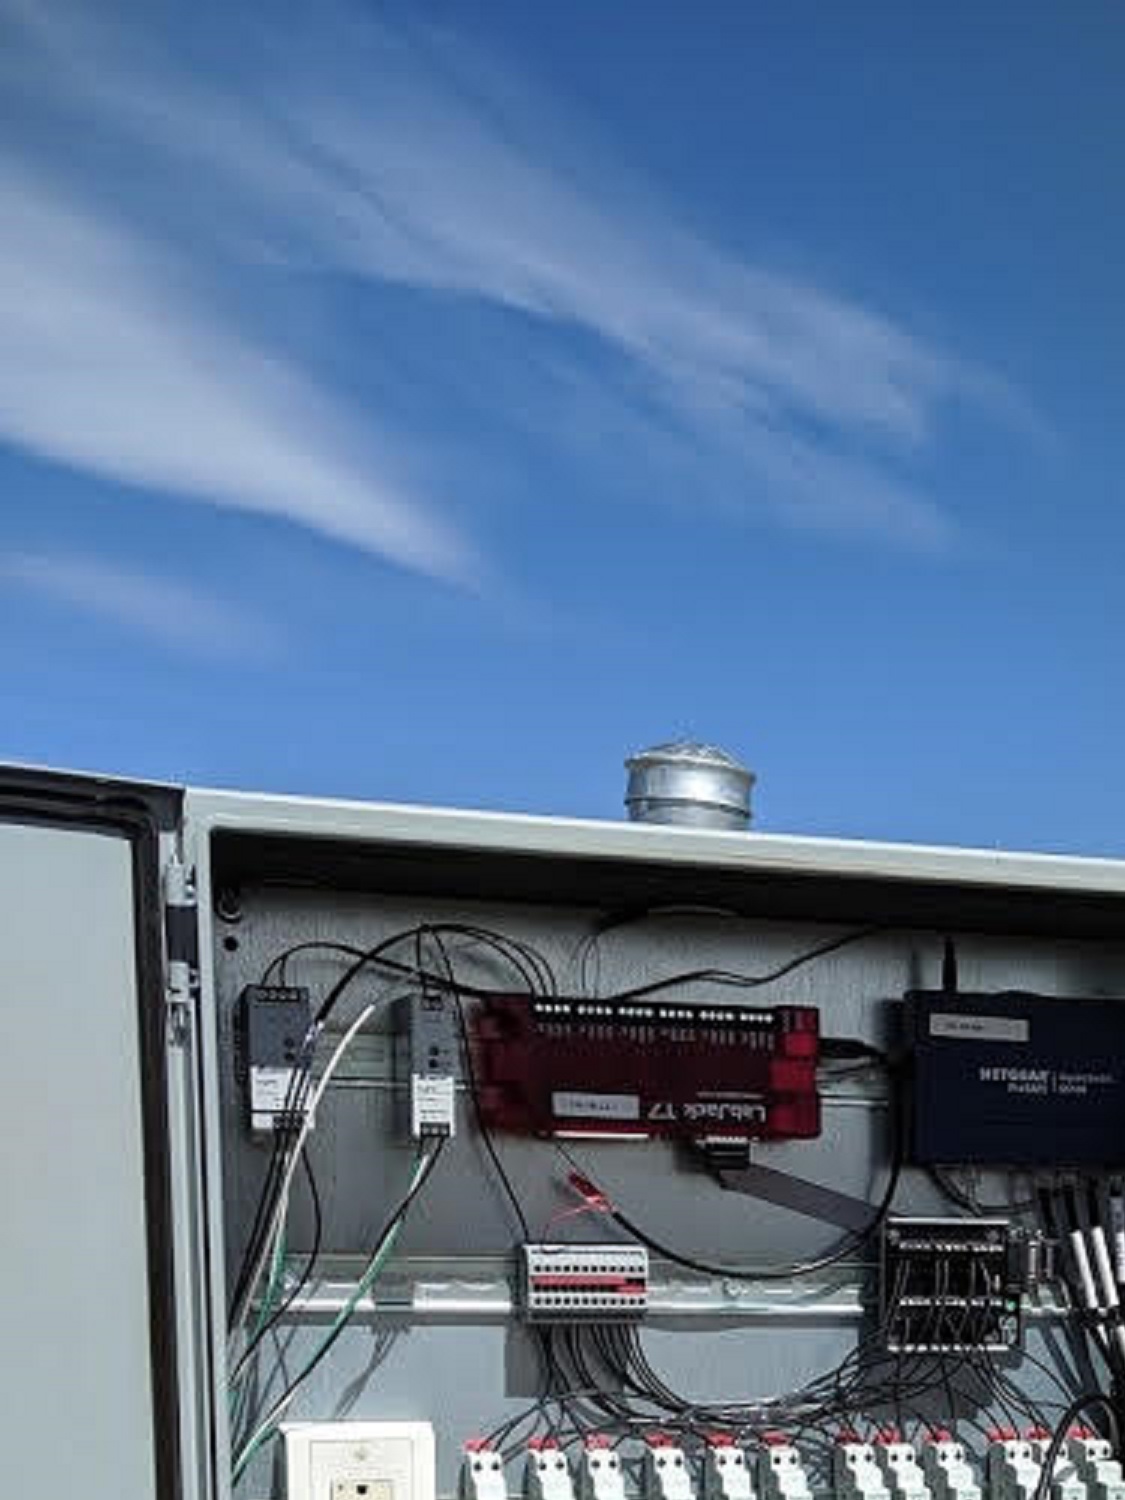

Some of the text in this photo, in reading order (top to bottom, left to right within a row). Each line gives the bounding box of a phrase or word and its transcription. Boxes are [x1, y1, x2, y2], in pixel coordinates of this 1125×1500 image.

[979, 1066, 1049, 1082] NETGEAR
[647, 1103, 766, 1122] LabJack T7
